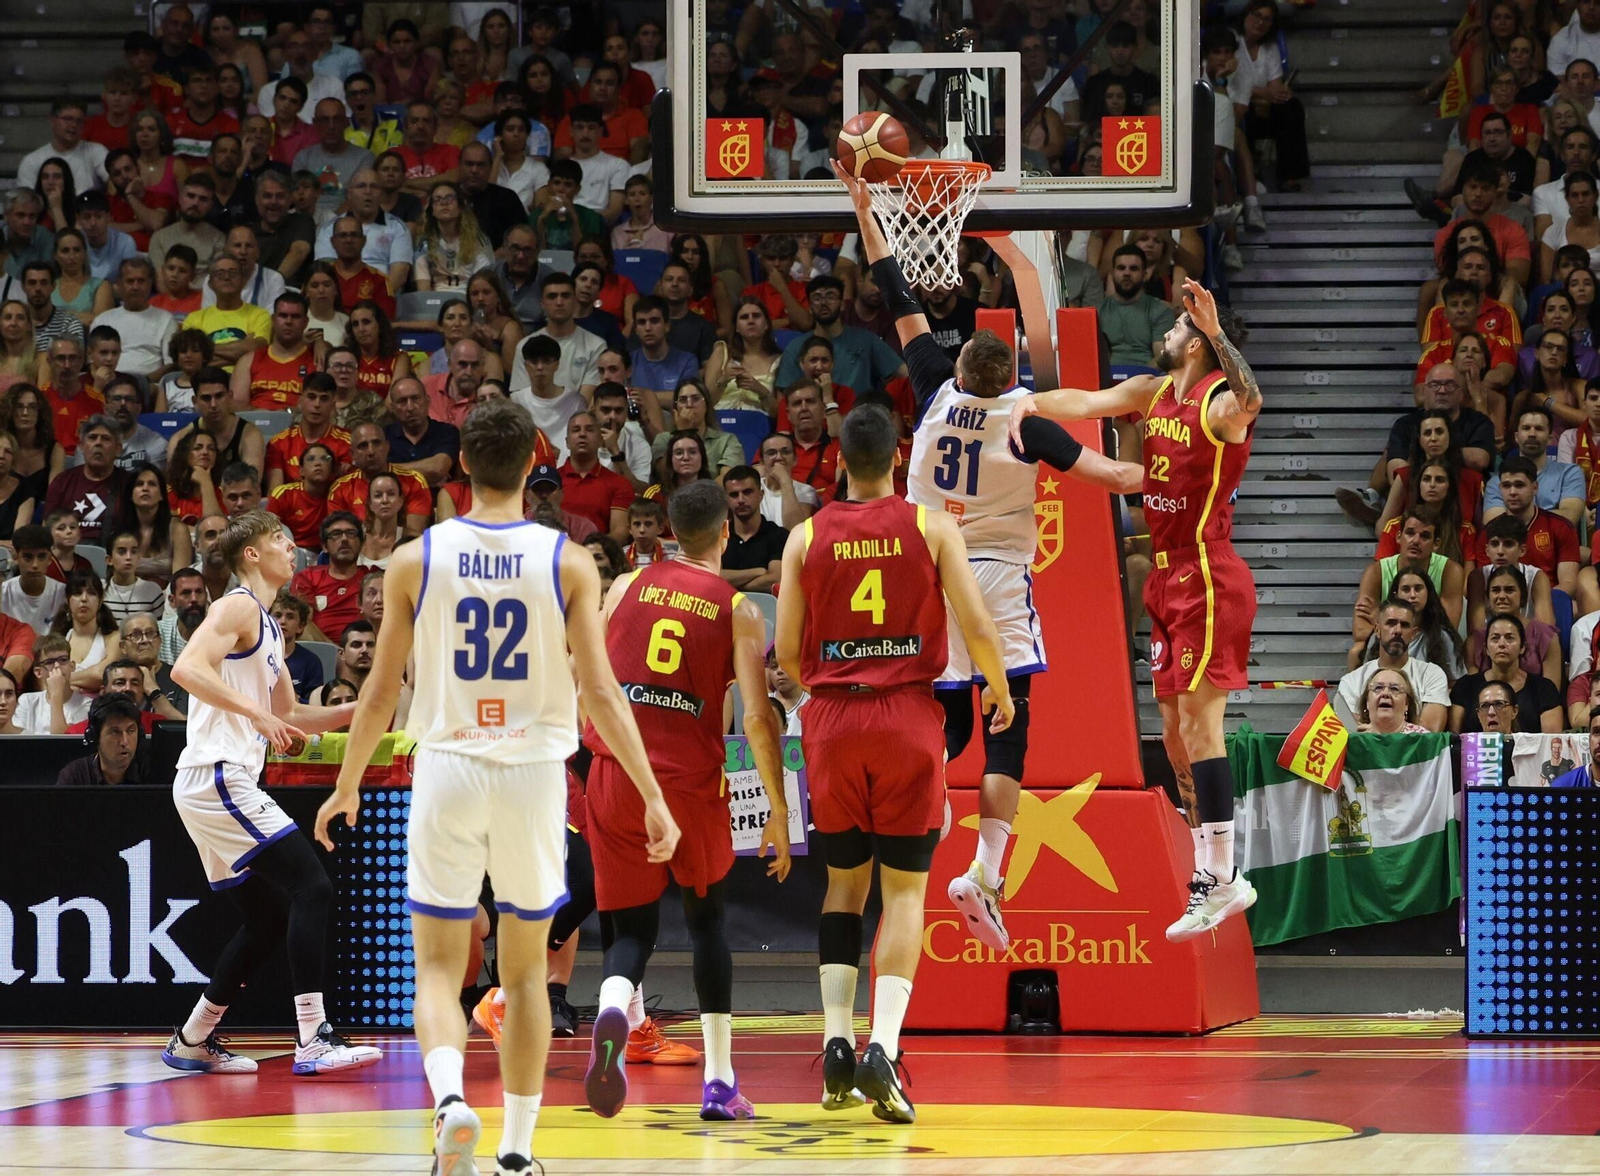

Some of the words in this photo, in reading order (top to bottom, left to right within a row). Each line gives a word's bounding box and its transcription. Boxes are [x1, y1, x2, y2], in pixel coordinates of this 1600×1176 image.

[251, 379, 304, 394] ESPAÑ
[1310, 374, 1325, 383] 12
[945, 405, 989, 431] KŘÍŽ
[1300, 418, 1313, 426] 11
[1144, 417, 1191, 449] ESPAÑA
[933, 435, 983, 497] 31
[1149, 454, 1171, 483] 22
[1288, 459, 1303, 468] 10
[1041, 504, 1059, 513] FEB
[1280, 503, 1288, 512] 9
[833, 537, 903, 561] PRADILLA
[1271, 547, 1278, 555] 8
[458, 549, 525, 580] BÁLINT
[638, 583, 720, 622] LÓPEZ-AROSTEGUI
[850, 569, 886, 625] 4
[453, 596, 529, 681] 32
[645, 618, 686, 675] 6
[840, 638, 918, 660] CaixaBank
[1234, 692, 1242, 701] 5
[453, 729, 504, 741] SKUPINA
[1304, 715, 1345, 779] ESPAÑ
[729, 772, 761, 787] CAMBI
[731, 786, 768, 801] MISET
[739, 803, 757, 812] UNA
